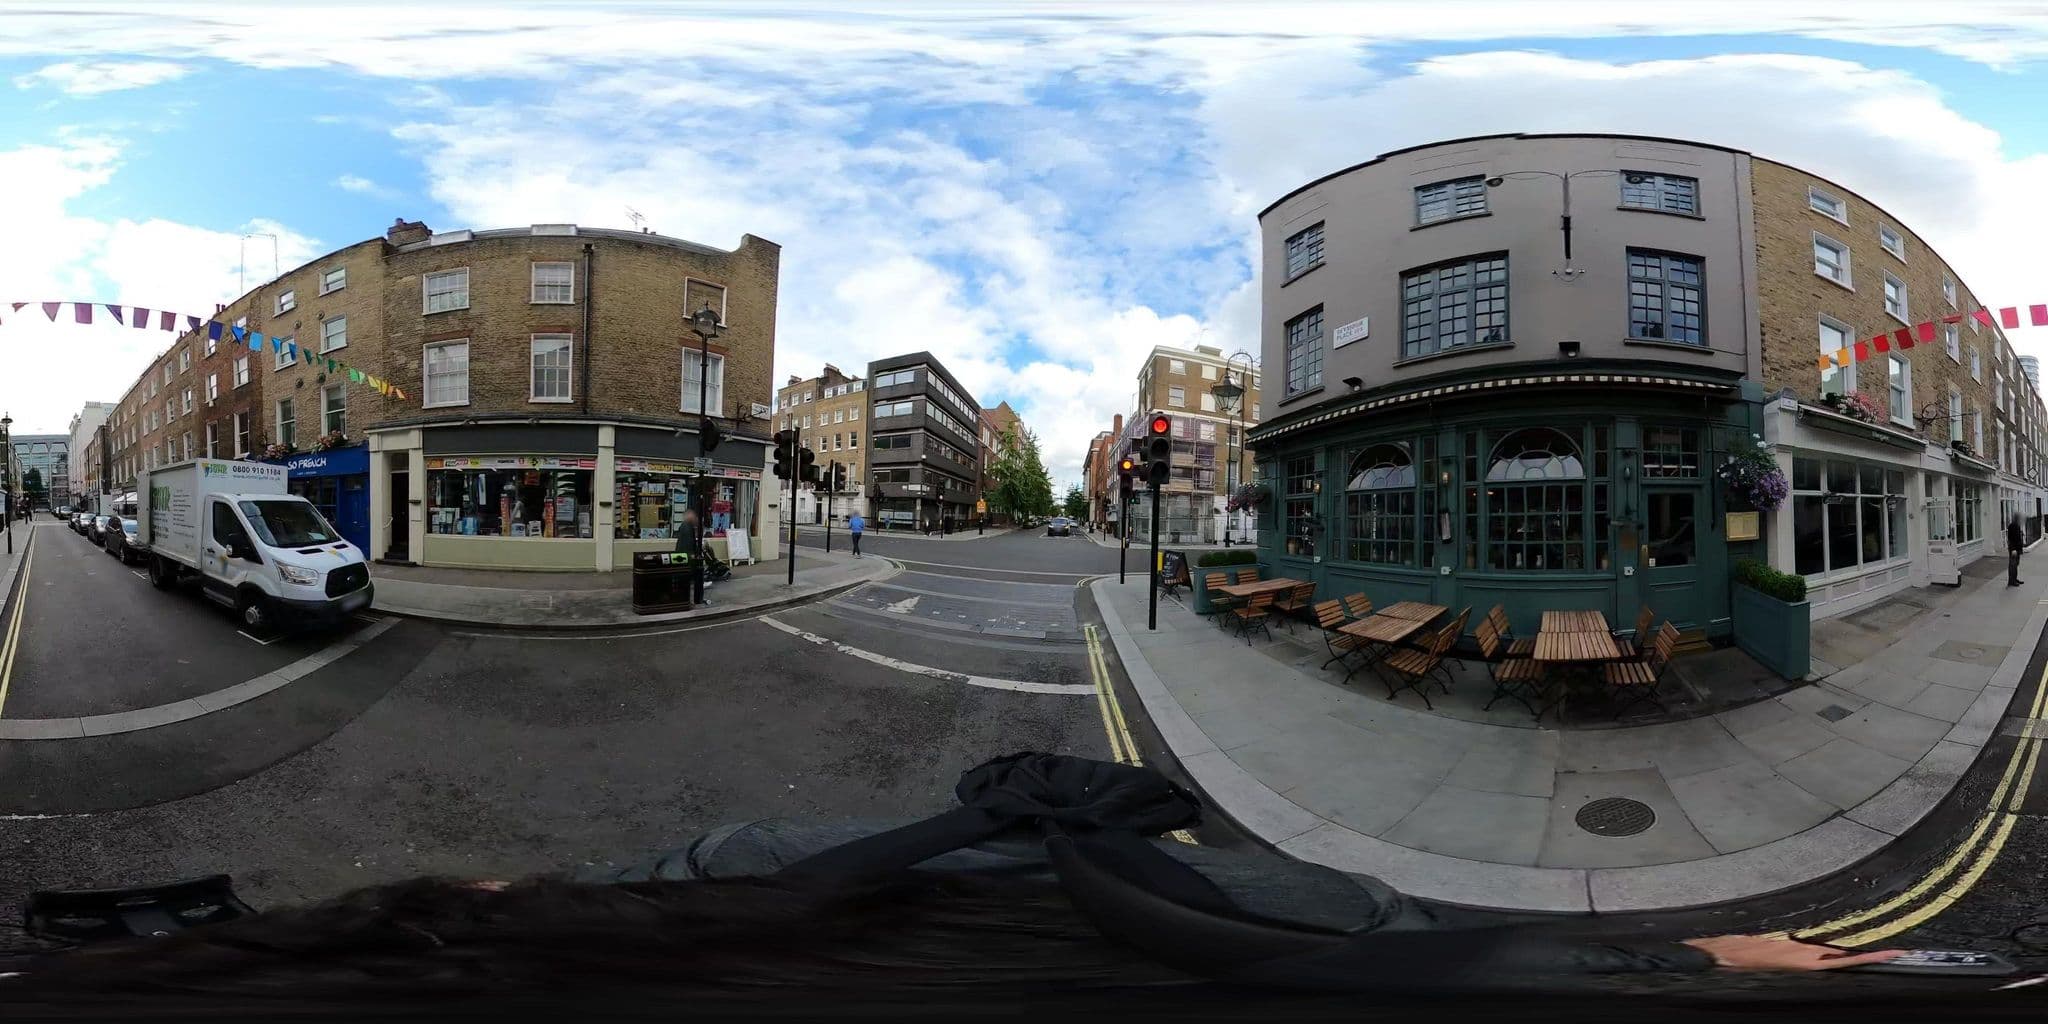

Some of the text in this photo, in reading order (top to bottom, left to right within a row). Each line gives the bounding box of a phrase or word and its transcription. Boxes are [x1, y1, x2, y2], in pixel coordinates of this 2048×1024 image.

[288, 457, 327, 470] SO FRENCH
[232, 465, 251, 474] 0800
[252, 467, 265, 475] 910
